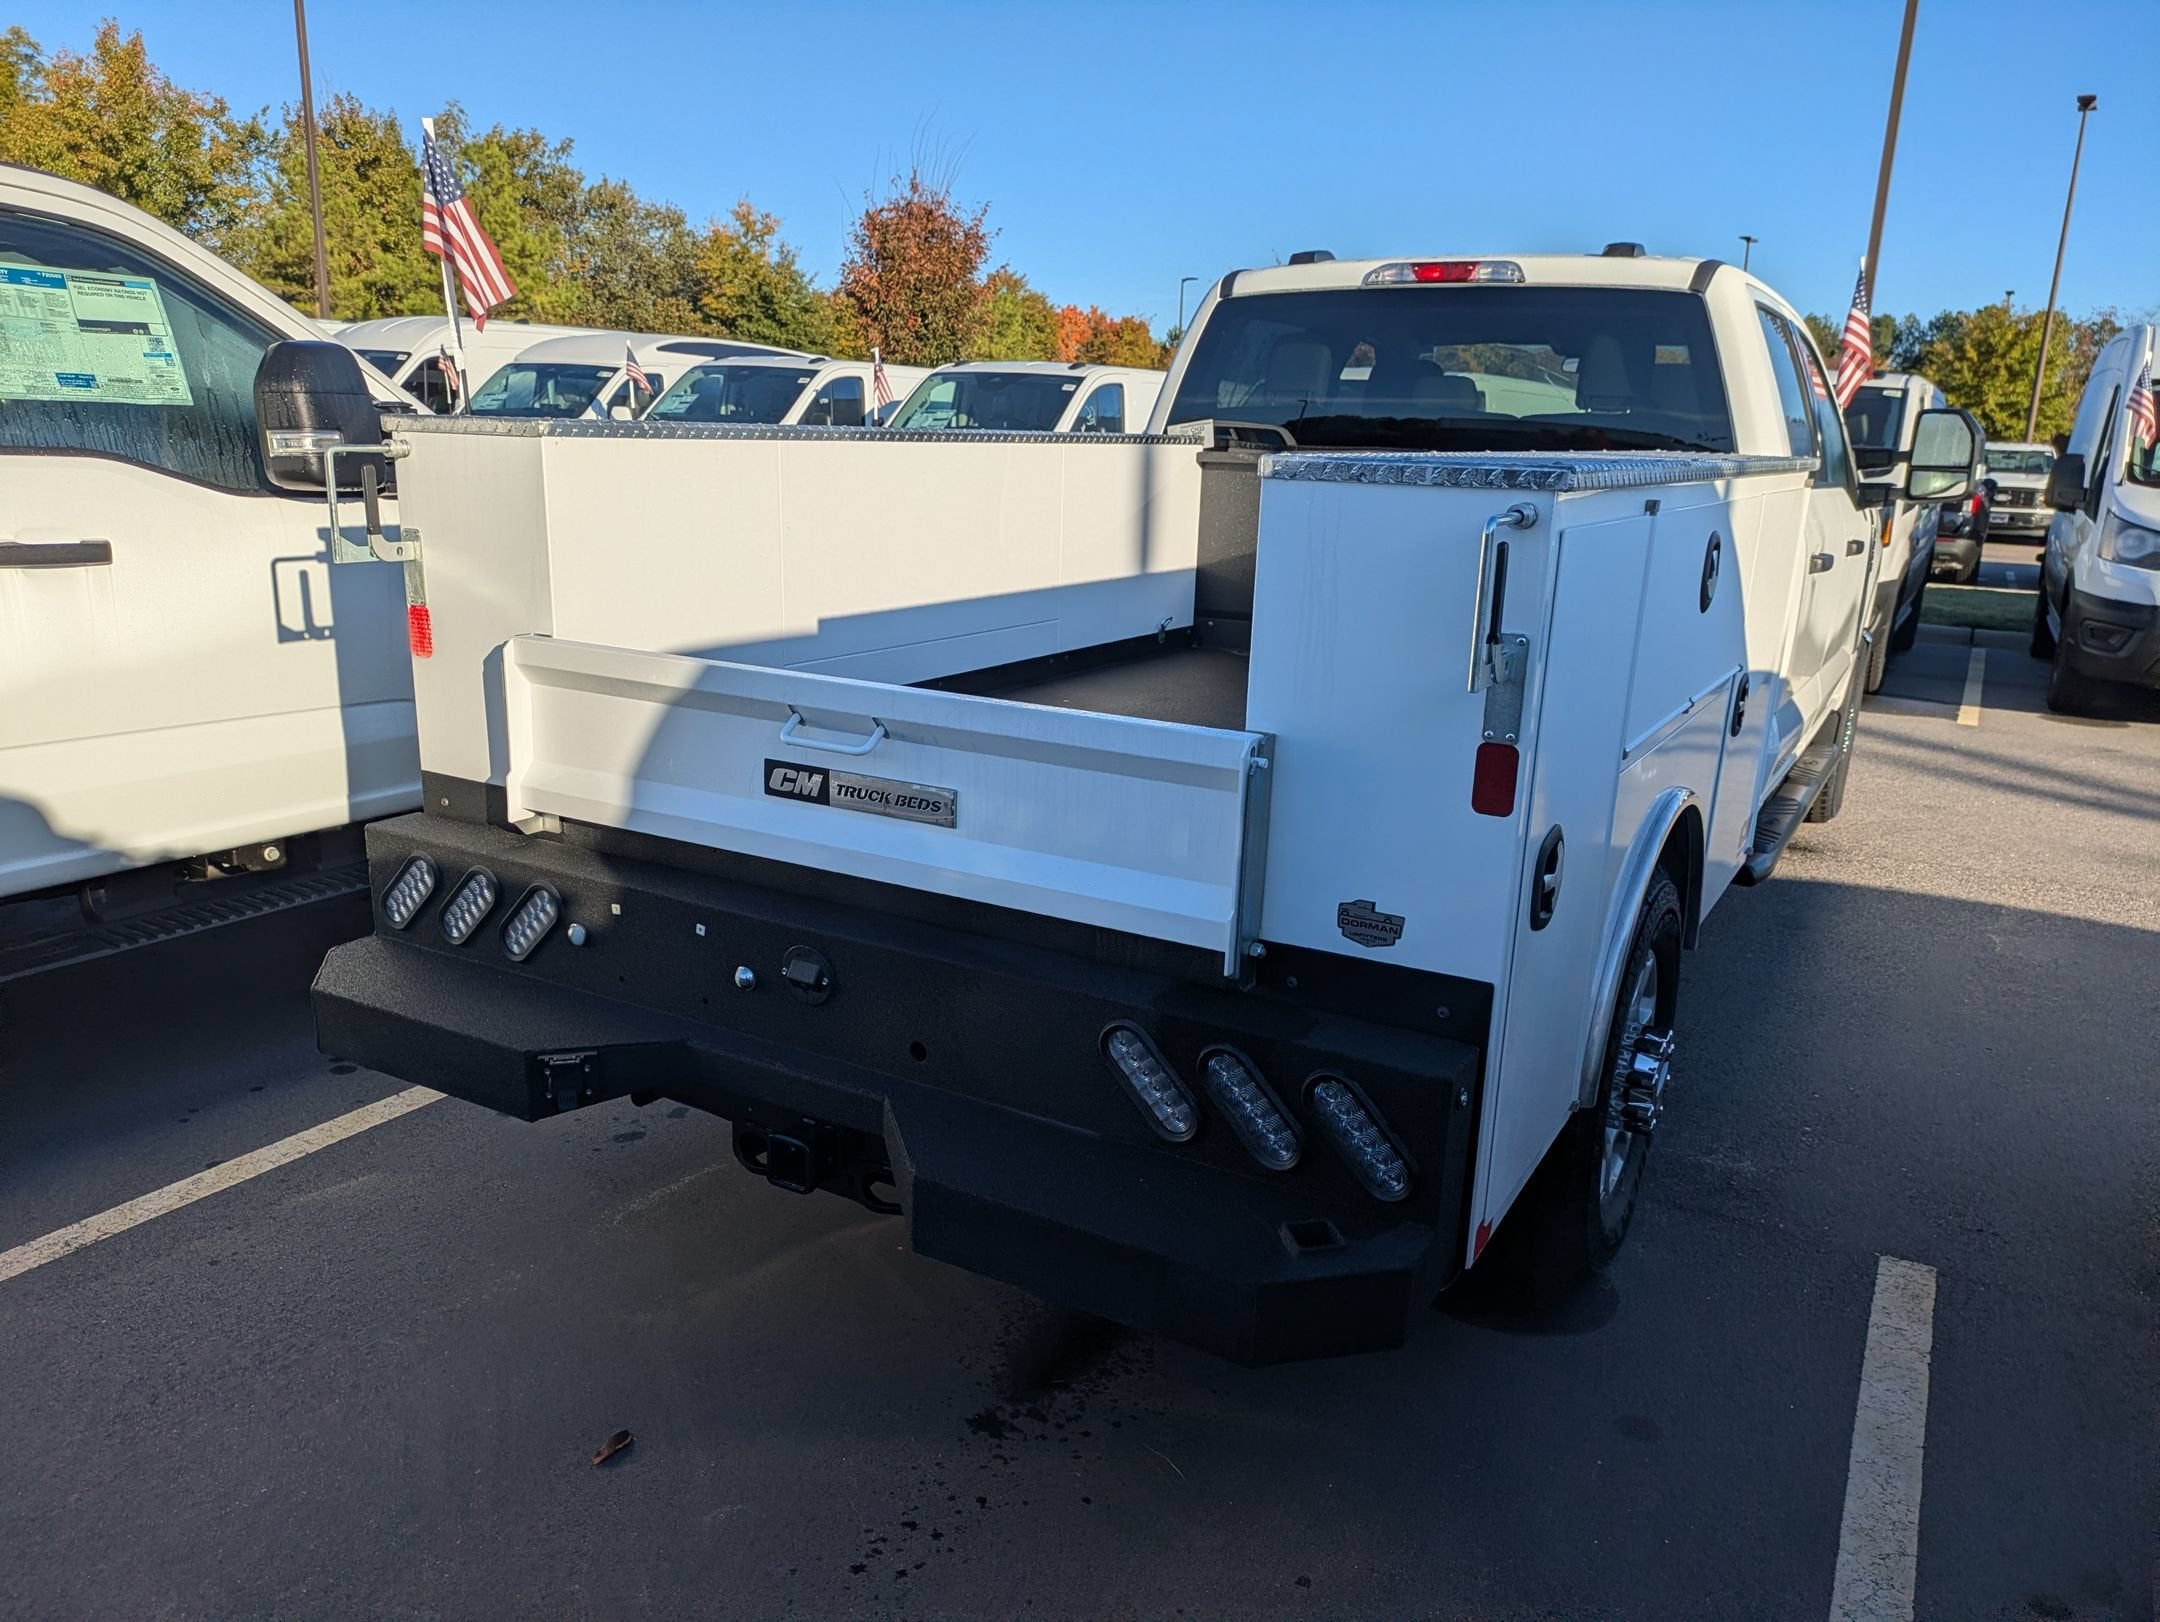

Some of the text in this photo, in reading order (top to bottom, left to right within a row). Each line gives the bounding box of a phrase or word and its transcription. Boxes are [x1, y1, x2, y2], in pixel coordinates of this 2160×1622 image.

[87, 285, 113, 293] ECONOMY
[768, 767, 944, 813] CM TRUCK BEDS
[1341, 917, 1399, 935] DORMAN
